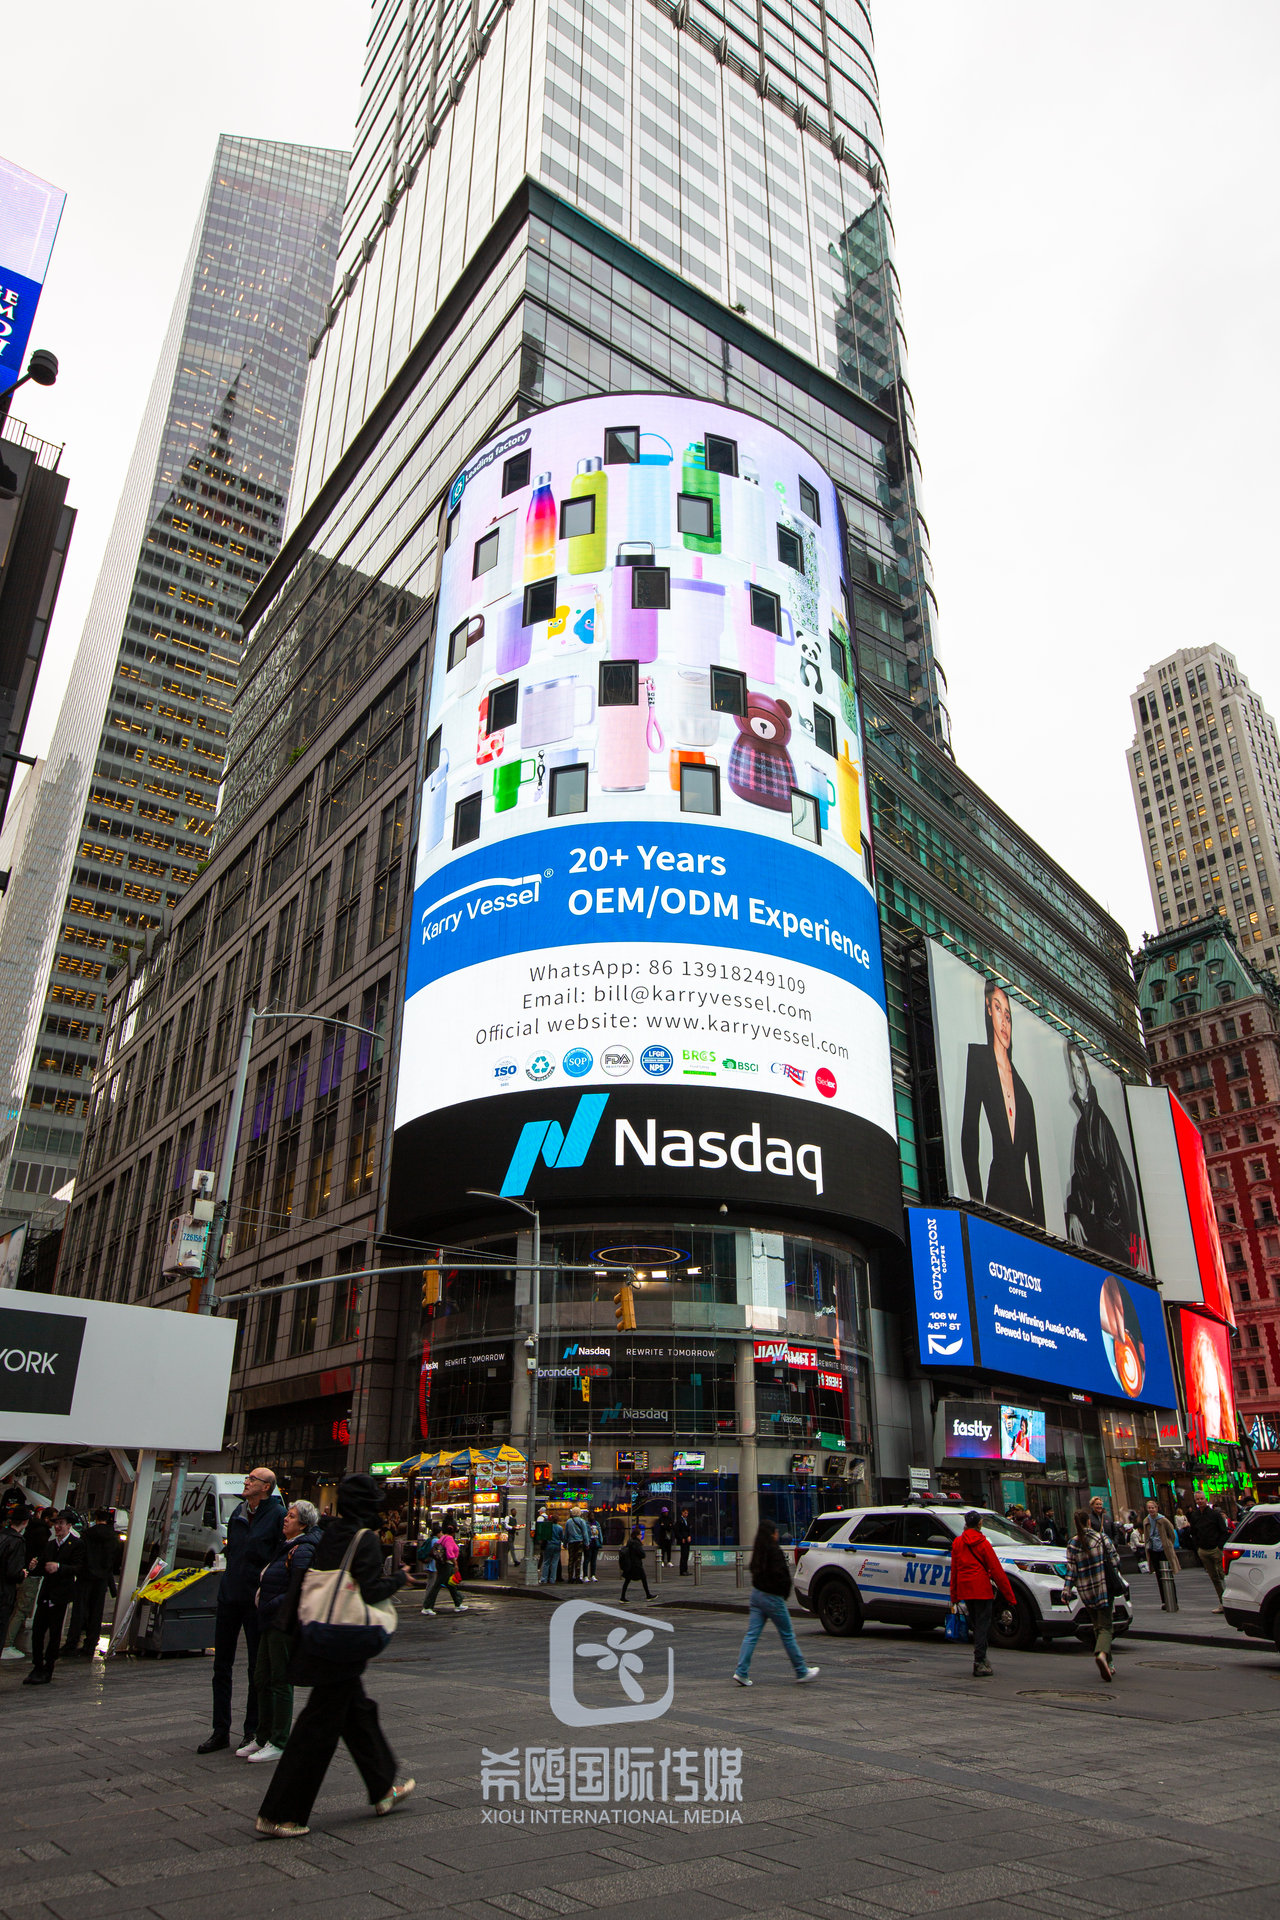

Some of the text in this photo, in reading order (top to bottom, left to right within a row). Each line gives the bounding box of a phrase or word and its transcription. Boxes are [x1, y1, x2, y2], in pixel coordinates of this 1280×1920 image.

[465, 432, 528, 482] Leading factory
[568, 845, 727, 876] 20+ Years
[422, 881, 540, 945] Karry Vessel
[568, 886, 870, 970] OEM/ODM Experience
[529, 959, 806, 994] WhatsApp: 86 13918249109
[523, 984, 812, 1022] Email: bill@karryvessel.com
[475, 1012, 849, 1060] Official website: www.karryvessel.com
[568, 1056, 588, 1066] SQP
[605, 1053, 631, 1064] FDA
[494, 1065, 517, 1077] ISO
[649, 1063, 664, 1072] NPS
[737, 1061, 759, 1073] BSCI
[816, 1076, 836, 1090] Sedex
[614, 1118, 824, 1196] Nasdaq
[182, 1232, 203, 1243] 726156
[927, 1217, 943, 1301] GUMPTION
[988, 1261, 1042, 1293] GUMPTION
[1008, 1286, 1028, 1298] COFFEE
[929, 1312, 958, 1321] 106 W
[993, 1303, 1088, 1342] Award-Winning Aussie Coffee.
[949, 1322, 962, 1331] ST
[994, 1321, 1058, 1350] Brewed to Impress.
[578, 1347, 716, 1357] Nasdaq REWRITE TOMORROW
[444, 1356, 467, 1367] REWRITE
[468, 1353, 505, 1364] TOMORROW
[537, 1366, 609, 1377] brandedcities
[623, 1408, 669, 1422] Nasdaq
[953, 1419, 993, 1441] fastly.
